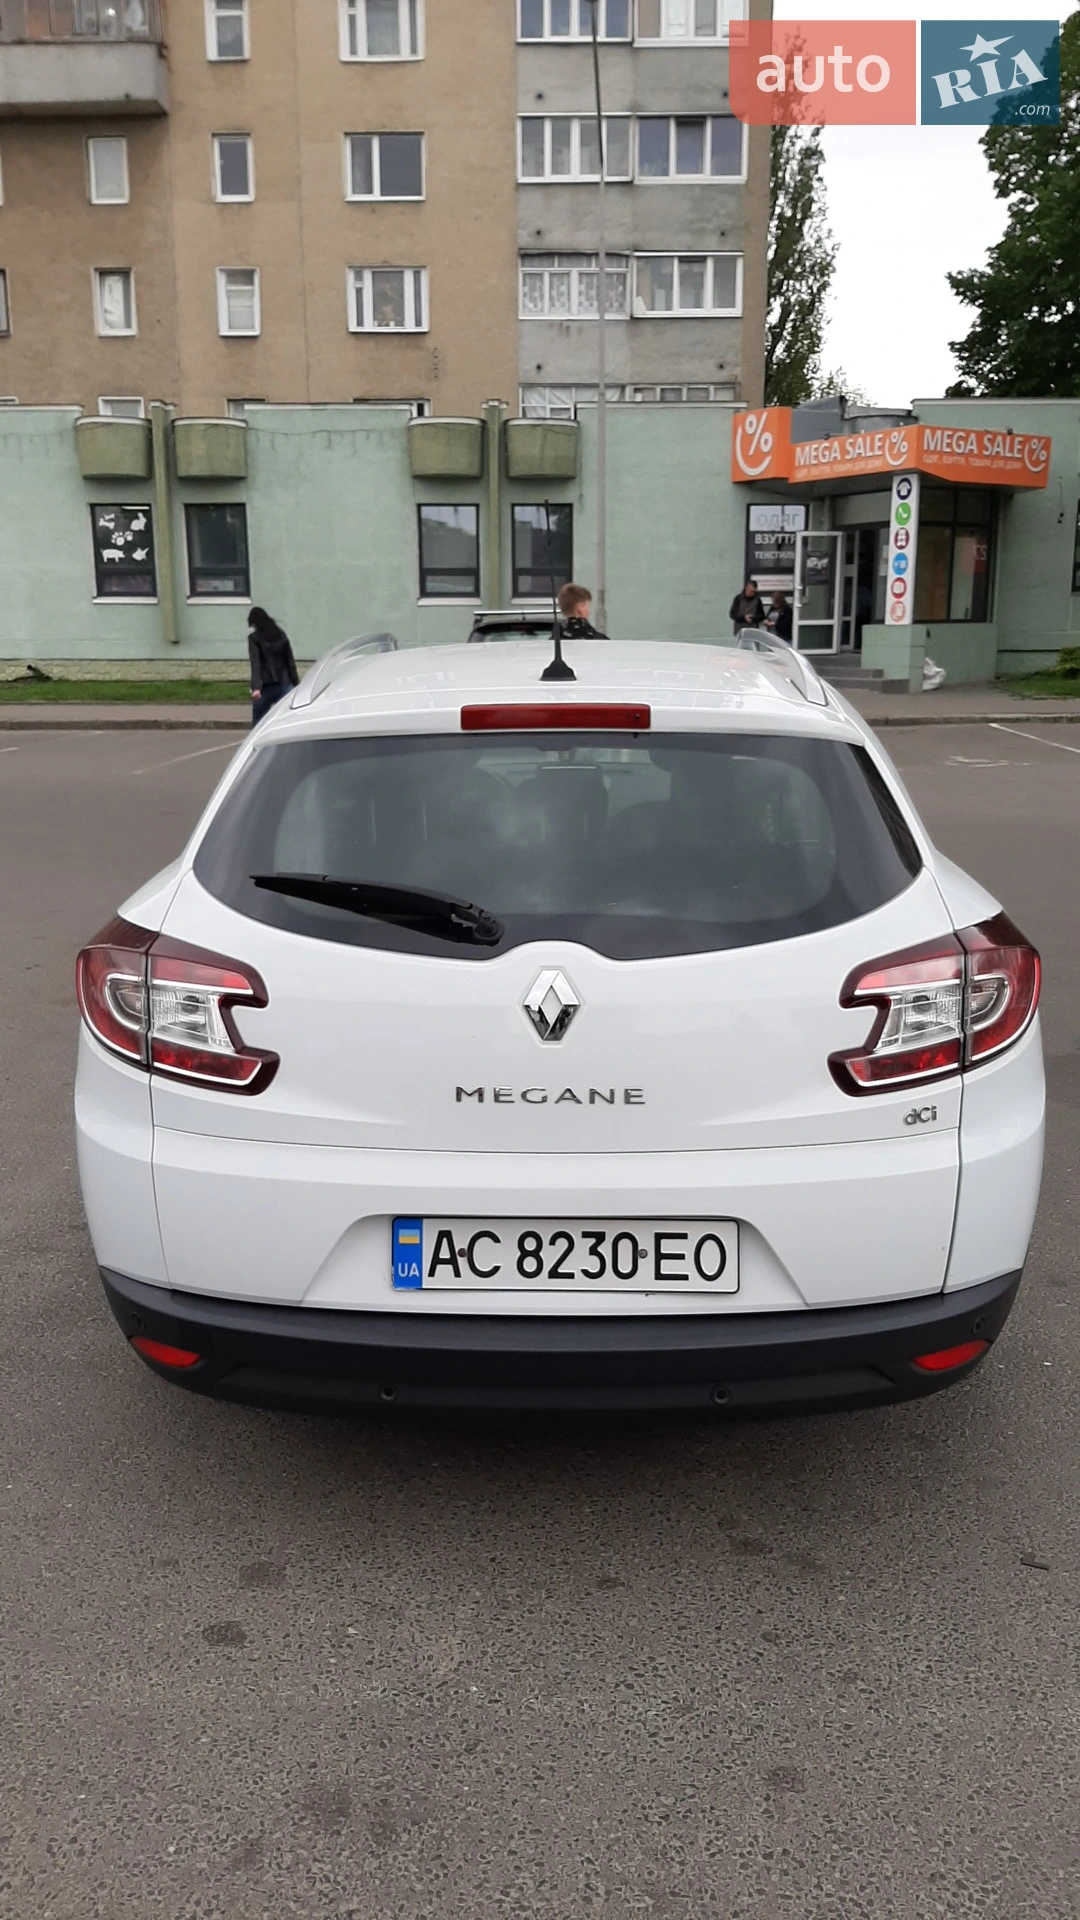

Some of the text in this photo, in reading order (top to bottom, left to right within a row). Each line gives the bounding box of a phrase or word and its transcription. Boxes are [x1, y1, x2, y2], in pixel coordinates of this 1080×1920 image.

[795, 441, 841, 467] MEGA
[845, 433, 884, 460] SALE
[923, 428, 978, 454] MEGA
[982, 434, 1024, 458] SALE
[756, 513, 799, 529] ОДЯГ
[455, 1085, 646, 1105] MEGANE
[903, 1105, 938, 1126] dCi
[428, 1229, 727, 1282] AC 8230 EO
[398, 1262, 420, 1278] UA
